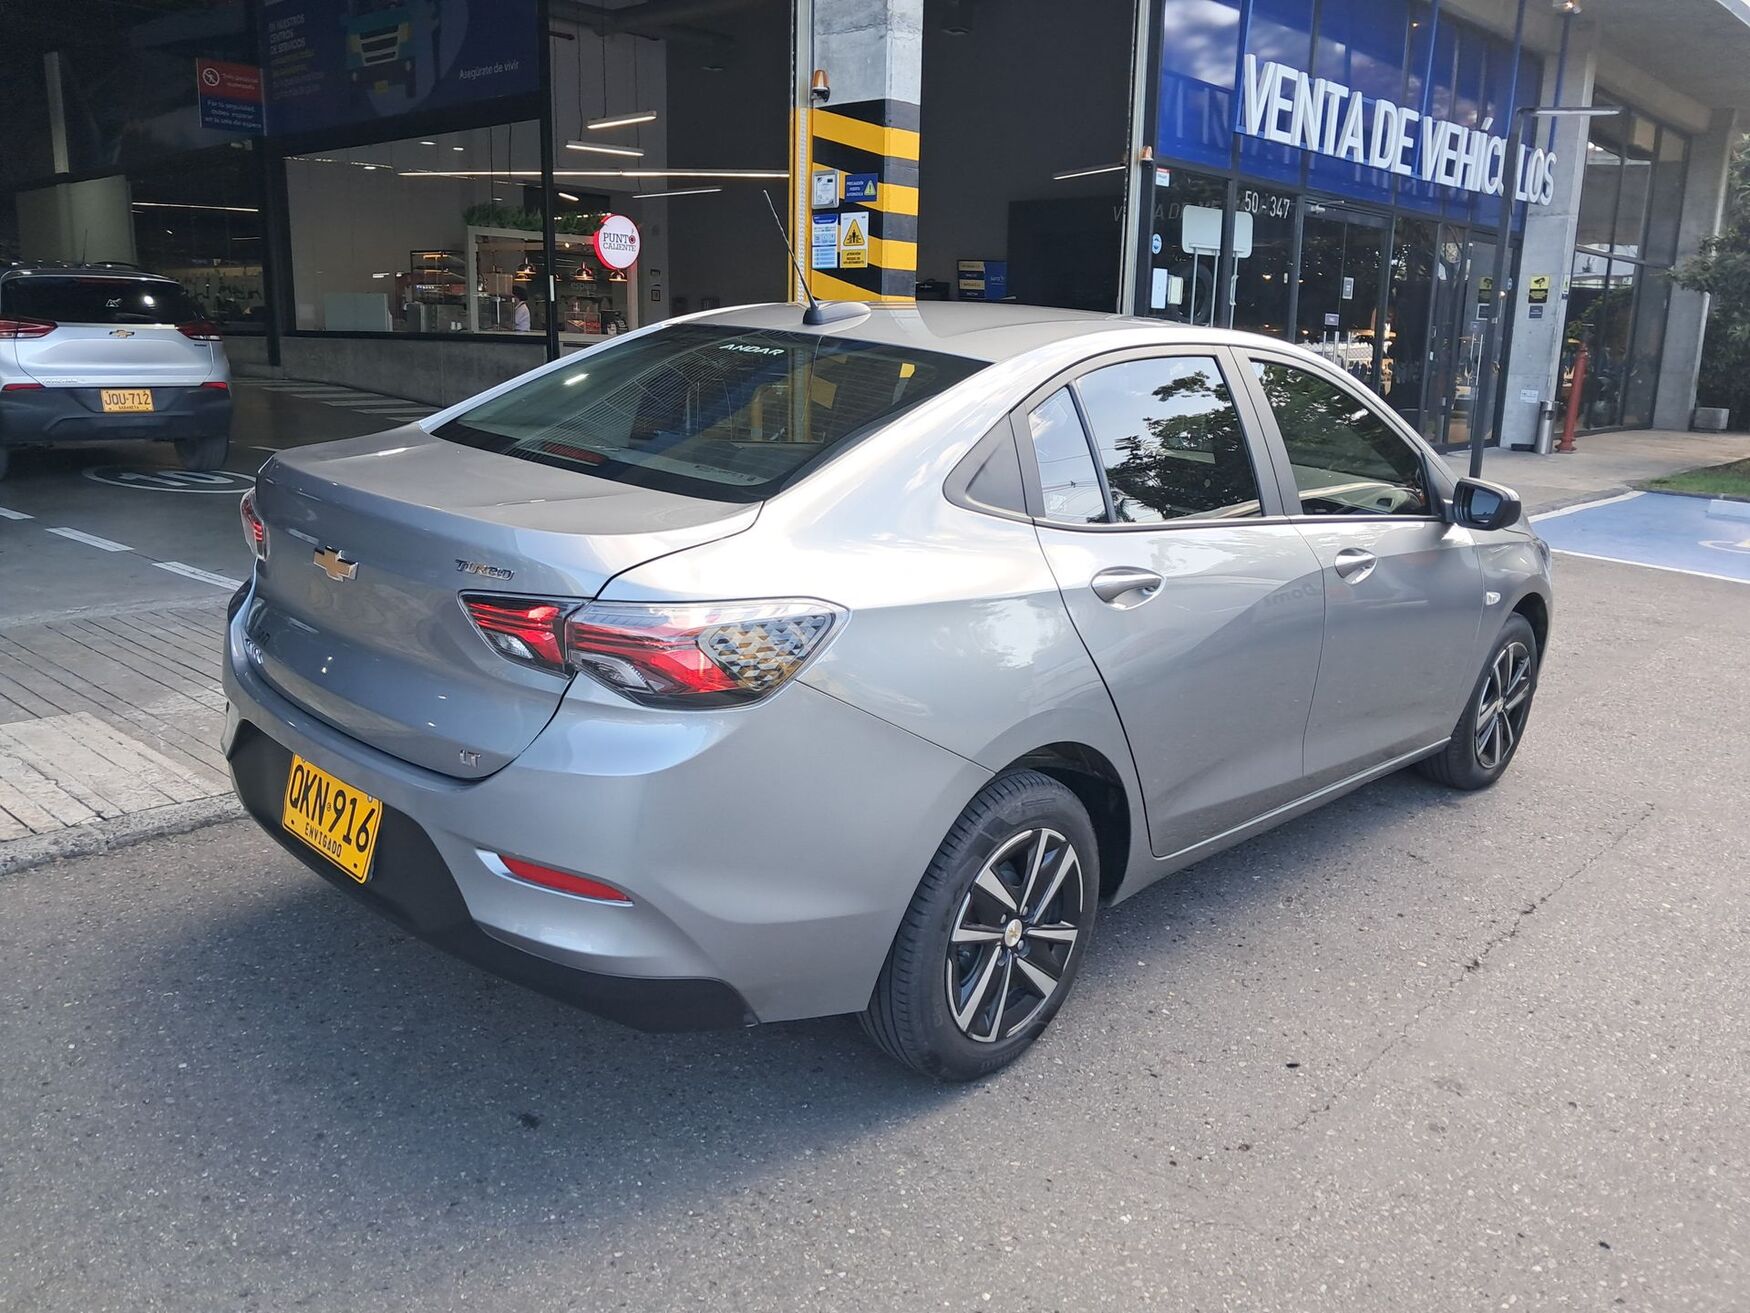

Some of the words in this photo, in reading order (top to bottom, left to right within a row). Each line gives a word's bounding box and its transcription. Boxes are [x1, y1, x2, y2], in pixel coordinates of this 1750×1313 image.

[494, 61, 503, 73] de
[504, 58, 519, 71] vivir
[1244, 54, 1364, 163] VENTA
[1370, 99, 1420, 176] DE
[1244, 191, 1259, 213] 50
[1269, 196, 1290, 220] 347
[603, 232, 636, 244] PUNTO
[603, 243, 636, 252] CALIENTE
[718, 344, 785, 356] ANDAR
[455, 559, 515, 581] TURBO
[459, 749, 481, 769] LT
[304, 822, 343, 858] ENVIGADO
